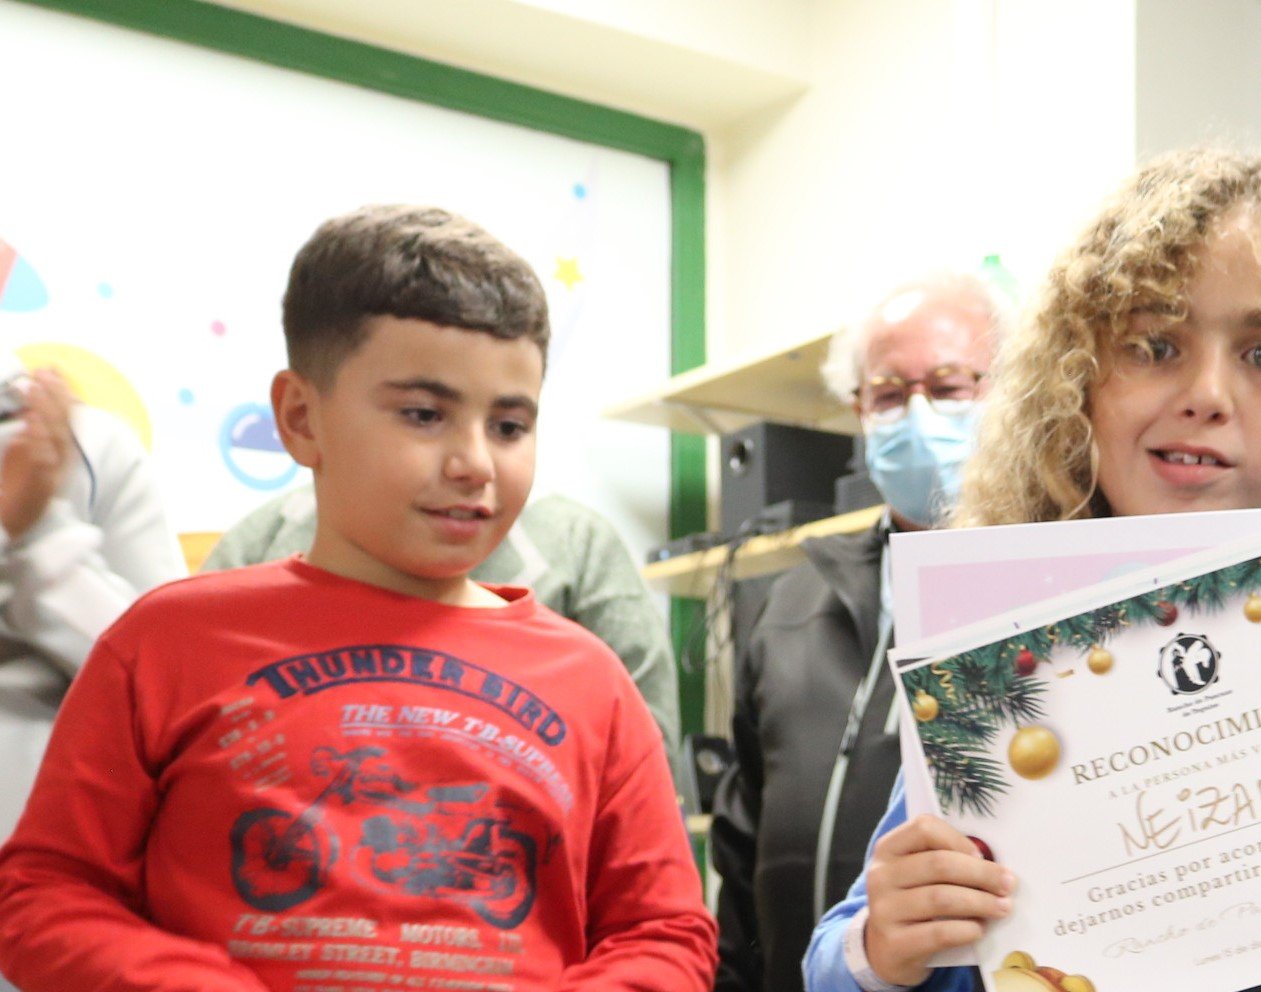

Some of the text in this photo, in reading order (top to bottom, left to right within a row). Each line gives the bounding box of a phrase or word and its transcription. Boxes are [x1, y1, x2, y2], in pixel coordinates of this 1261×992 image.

[246, 645, 567, 747] THUNDER BIRD
[341, 703, 392, 724] THE
[399, 705, 460, 727] NEW
[1120, 781, 1140, 795] LA
[1144, 761, 1213, 788] PERSONA
[1054, 901, 1146, 937] dejarnos
[1151, 864, 1261, 907] compartir
[1087, 872, 1168, 904] Gracias
[1174, 857, 1212, 882] por
